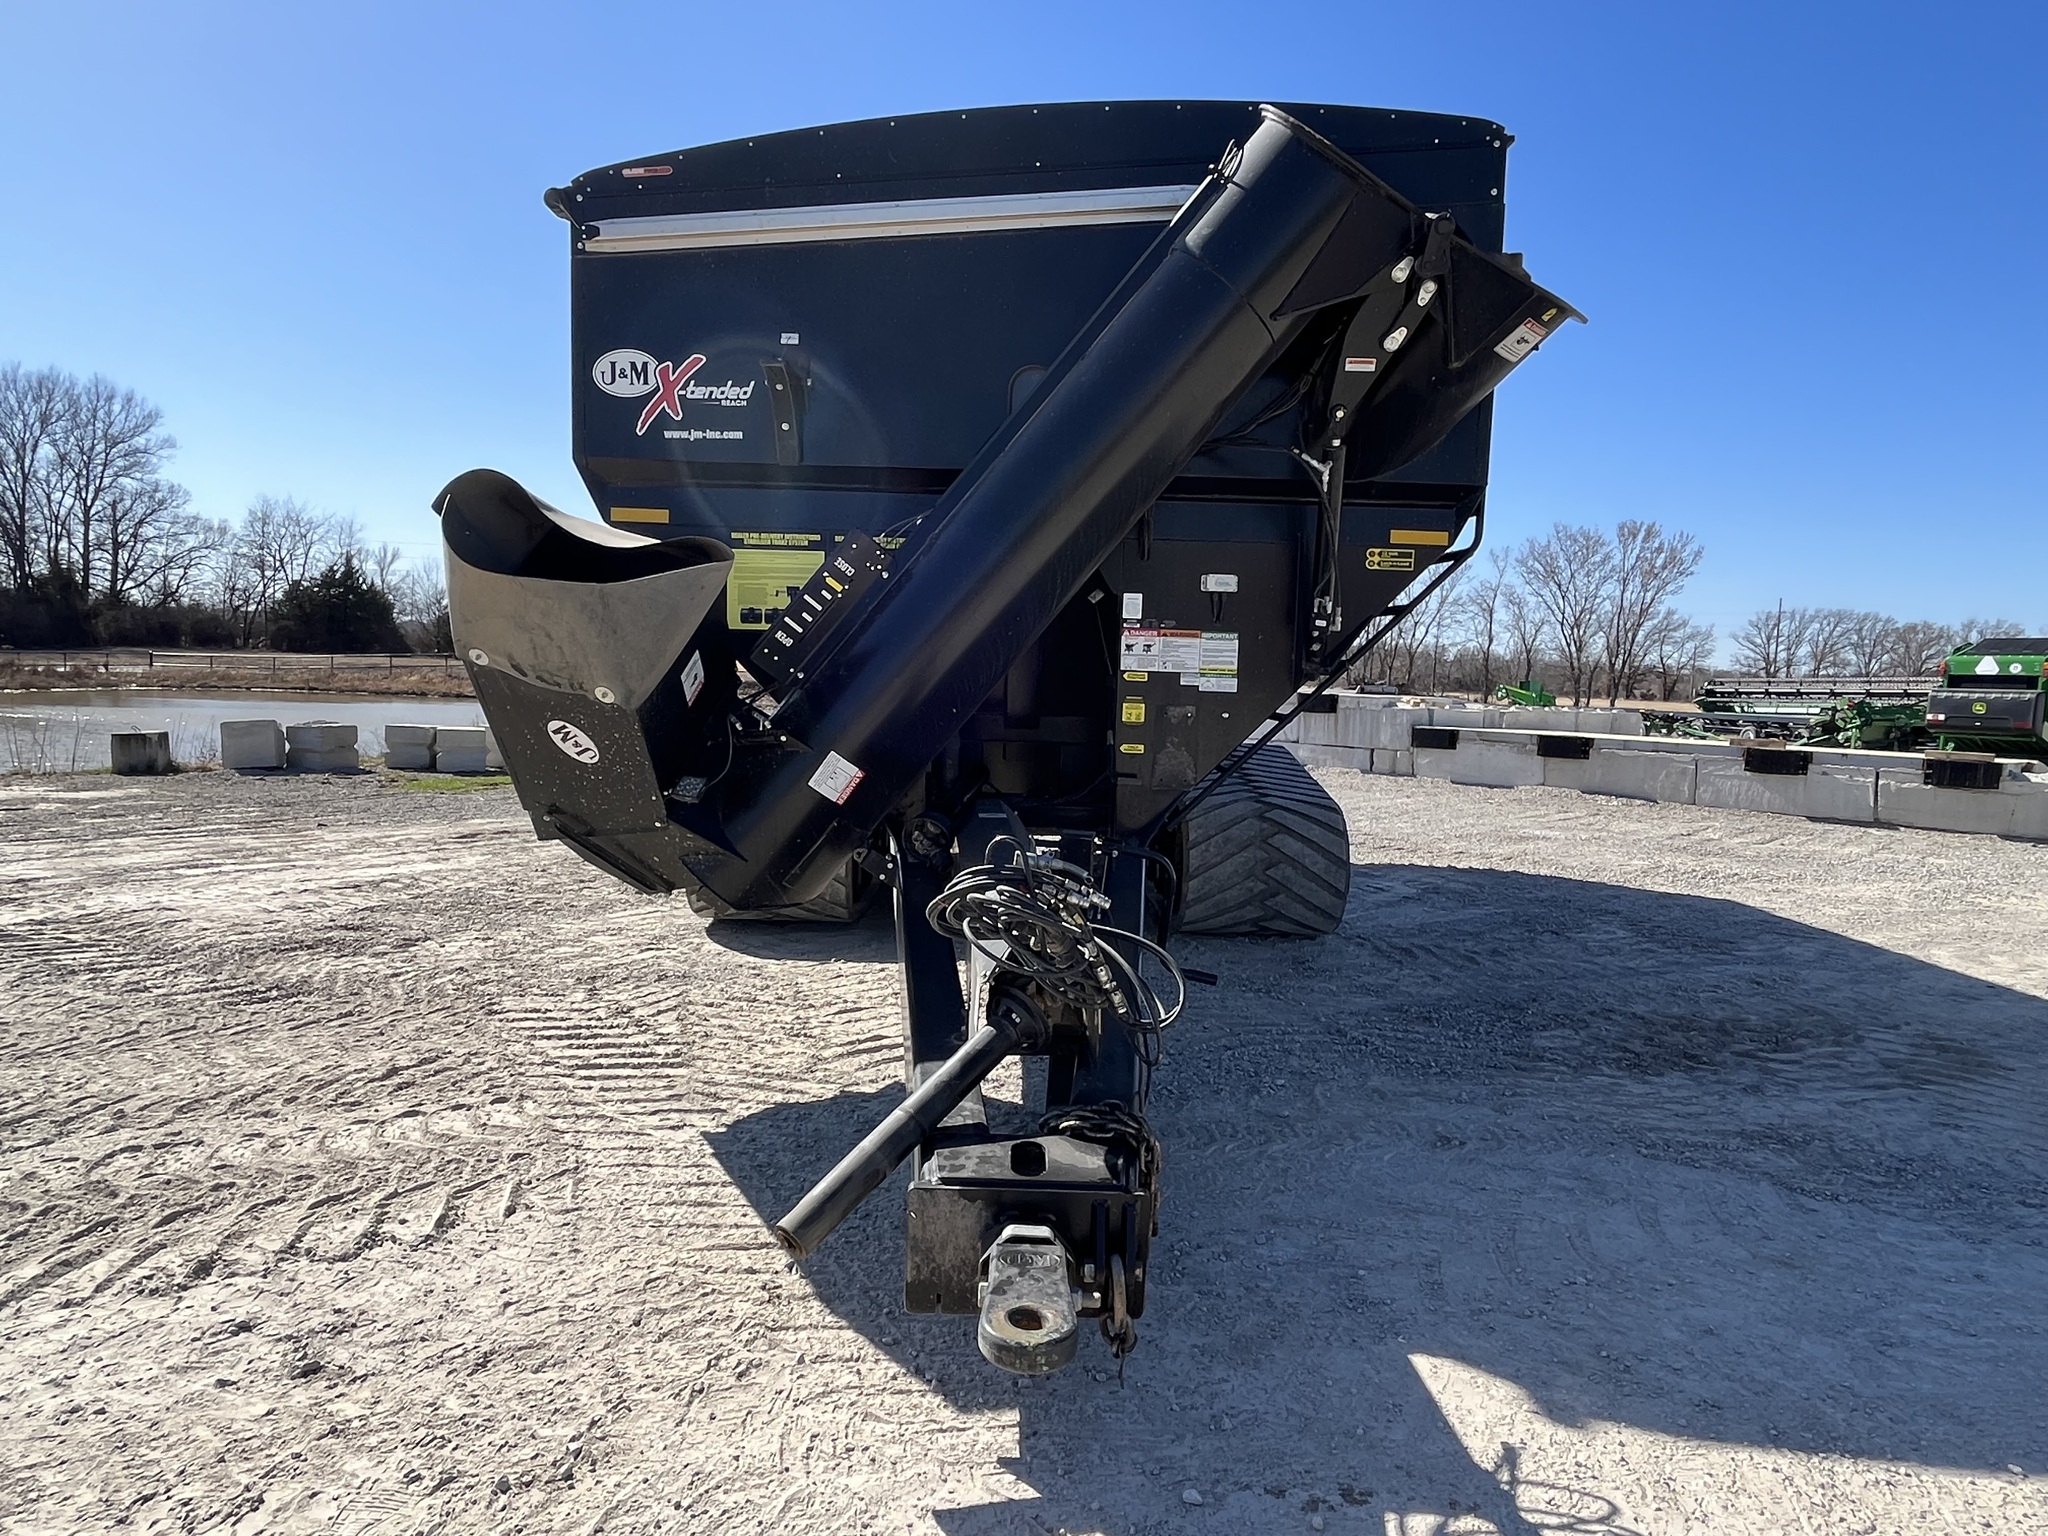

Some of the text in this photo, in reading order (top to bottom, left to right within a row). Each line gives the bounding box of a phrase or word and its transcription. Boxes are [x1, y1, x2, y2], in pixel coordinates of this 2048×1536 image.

[600, 360, 650, 387] J&M
[720, 399, 747, 407] REACH
[663, 428, 744, 442] www.jm-inc.com
[833, 556, 856, 577] CLOSE
[774, 630, 794, 647] OPEN
[550, 724, 598, 760] J&M
[836, 776, 861, 806] DANGER
